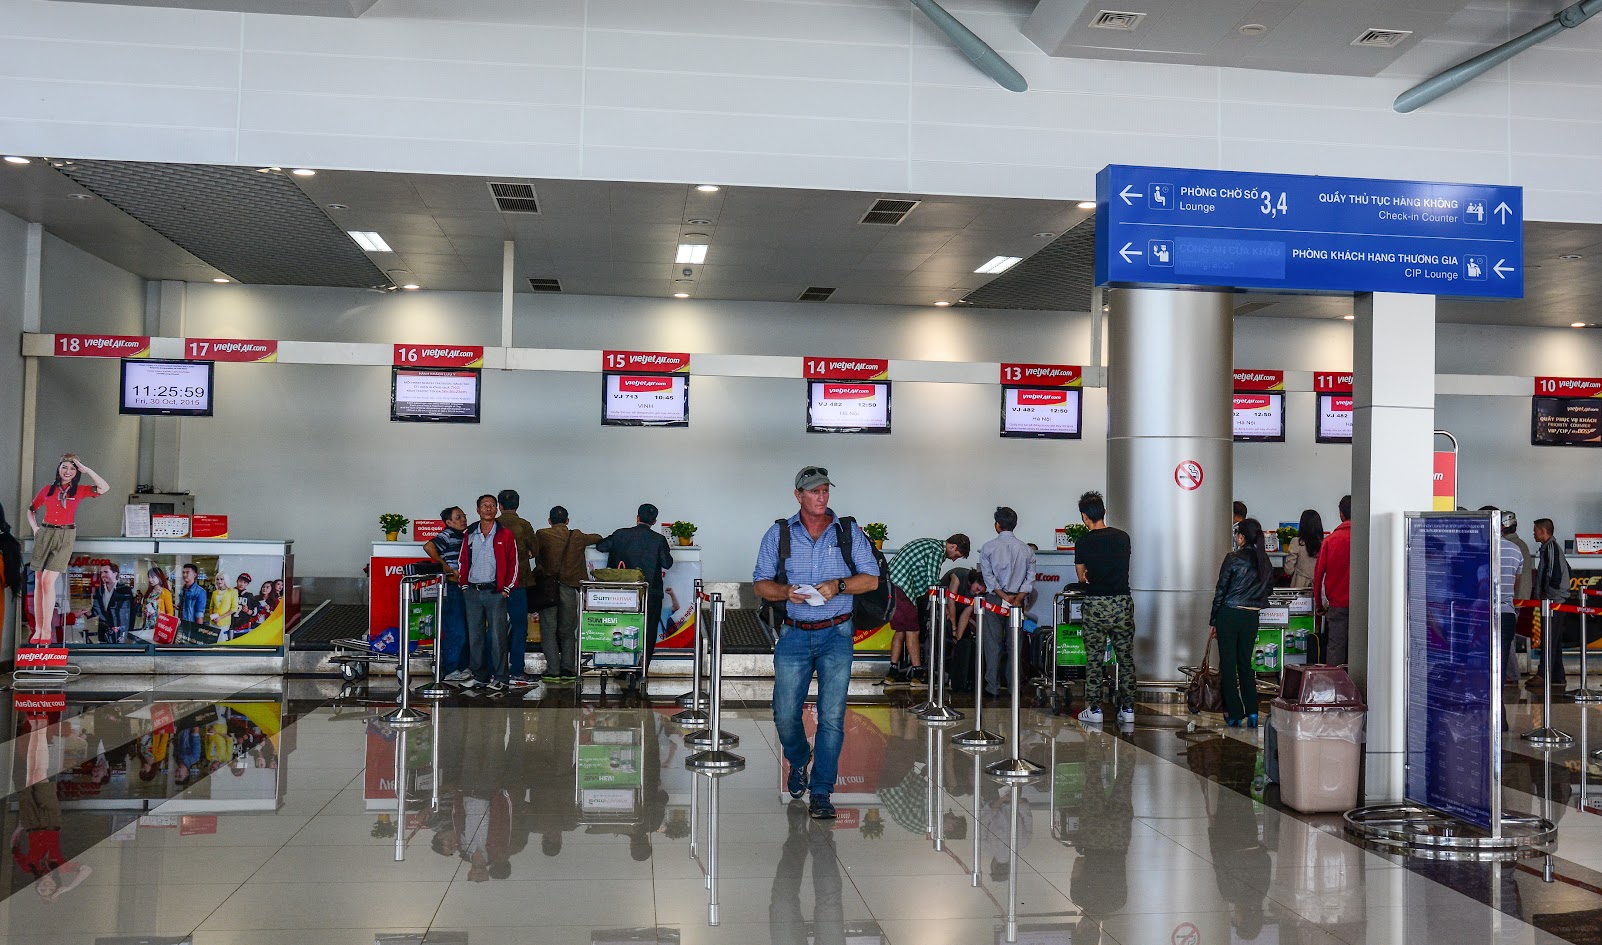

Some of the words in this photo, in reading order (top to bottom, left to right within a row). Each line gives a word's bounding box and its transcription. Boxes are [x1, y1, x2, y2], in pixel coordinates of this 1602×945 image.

[1180, 186, 1217, 198] PHÒNG
[1220, 187, 1242, 199] CHỜ
[1244, 187, 1259, 200] SỐ
[1260, 190, 1288, 218] 3,4
[1319, 190, 1346, 204] QUẦY
[1349, 193, 1369, 205] THỦ
[1371, 196, 1391, 207] TỤC
[1393, 196, 1421, 208] HÀNG
[1423, 198, 1458, 209] KHÔNG
[1179, 202, 1216, 214] Lounge
[1378, 211, 1419, 222] Check-in
[1421, 213, 1458, 224] Counter
[1292, 247, 1328, 259] PHÒNG
[1330, 249, 1365, 261] KHÁCH
[1367, 252, 1396, 263] HẠNG
[1398, 254, 1439, 265] THƯƠNG
[1441, 255, 1458, 265] GIA
[1404, 268, 1422, 278] CIP
[1424, 269, 1459, 281] Lounge
[60, 337, 80, 352] 18
[189, 342, 209, 356] 17
[398, 348, 418, 362] 16
[606, 354, 626, 368] 15
[807, 361, 826, 374] 14
[1004, 367, 1022, 381] 13
[1317, 375, 1333, 388] 11
[1540, 379, 1556, 392] 10
[132, 385, 205, 398] 11:25:59
